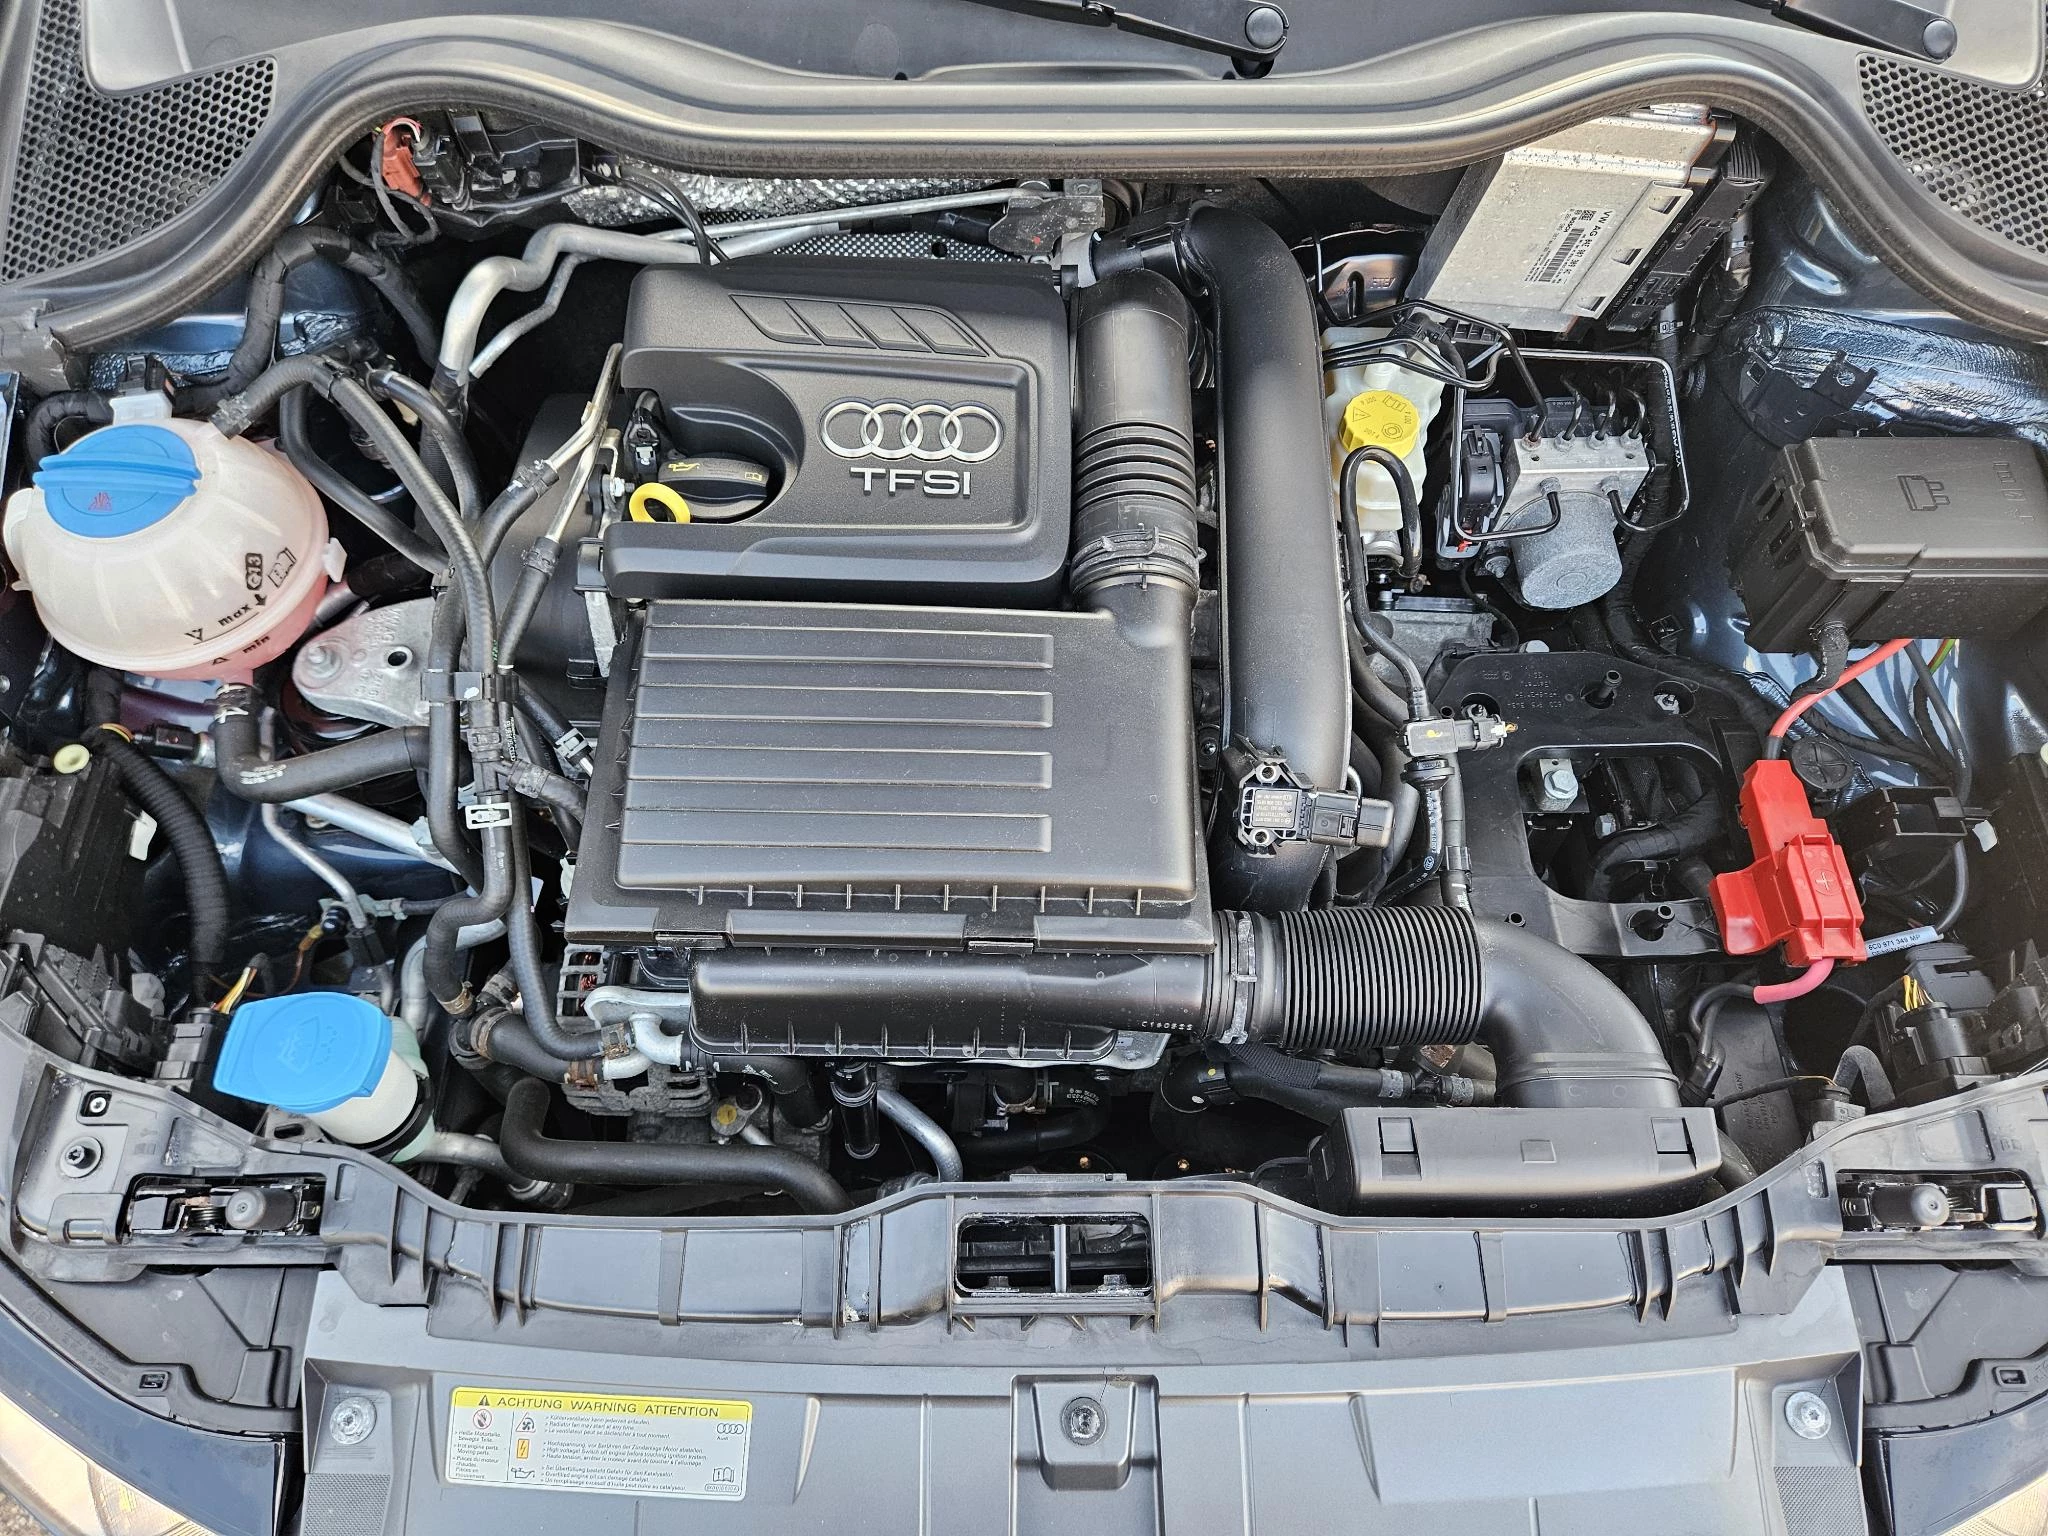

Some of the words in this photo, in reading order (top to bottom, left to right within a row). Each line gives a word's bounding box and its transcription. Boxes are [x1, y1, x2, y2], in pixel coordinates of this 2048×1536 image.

[850, 467, 971, 499] TFSI
[218, 604, 252, 626] max
[243, 636, 270, 653] min
[497, 1396, 562, 1409] ACHTUNG
[570, 1400, 636, 1413] WARNING
[644, 1403, 718, 1417] ATTENTION
